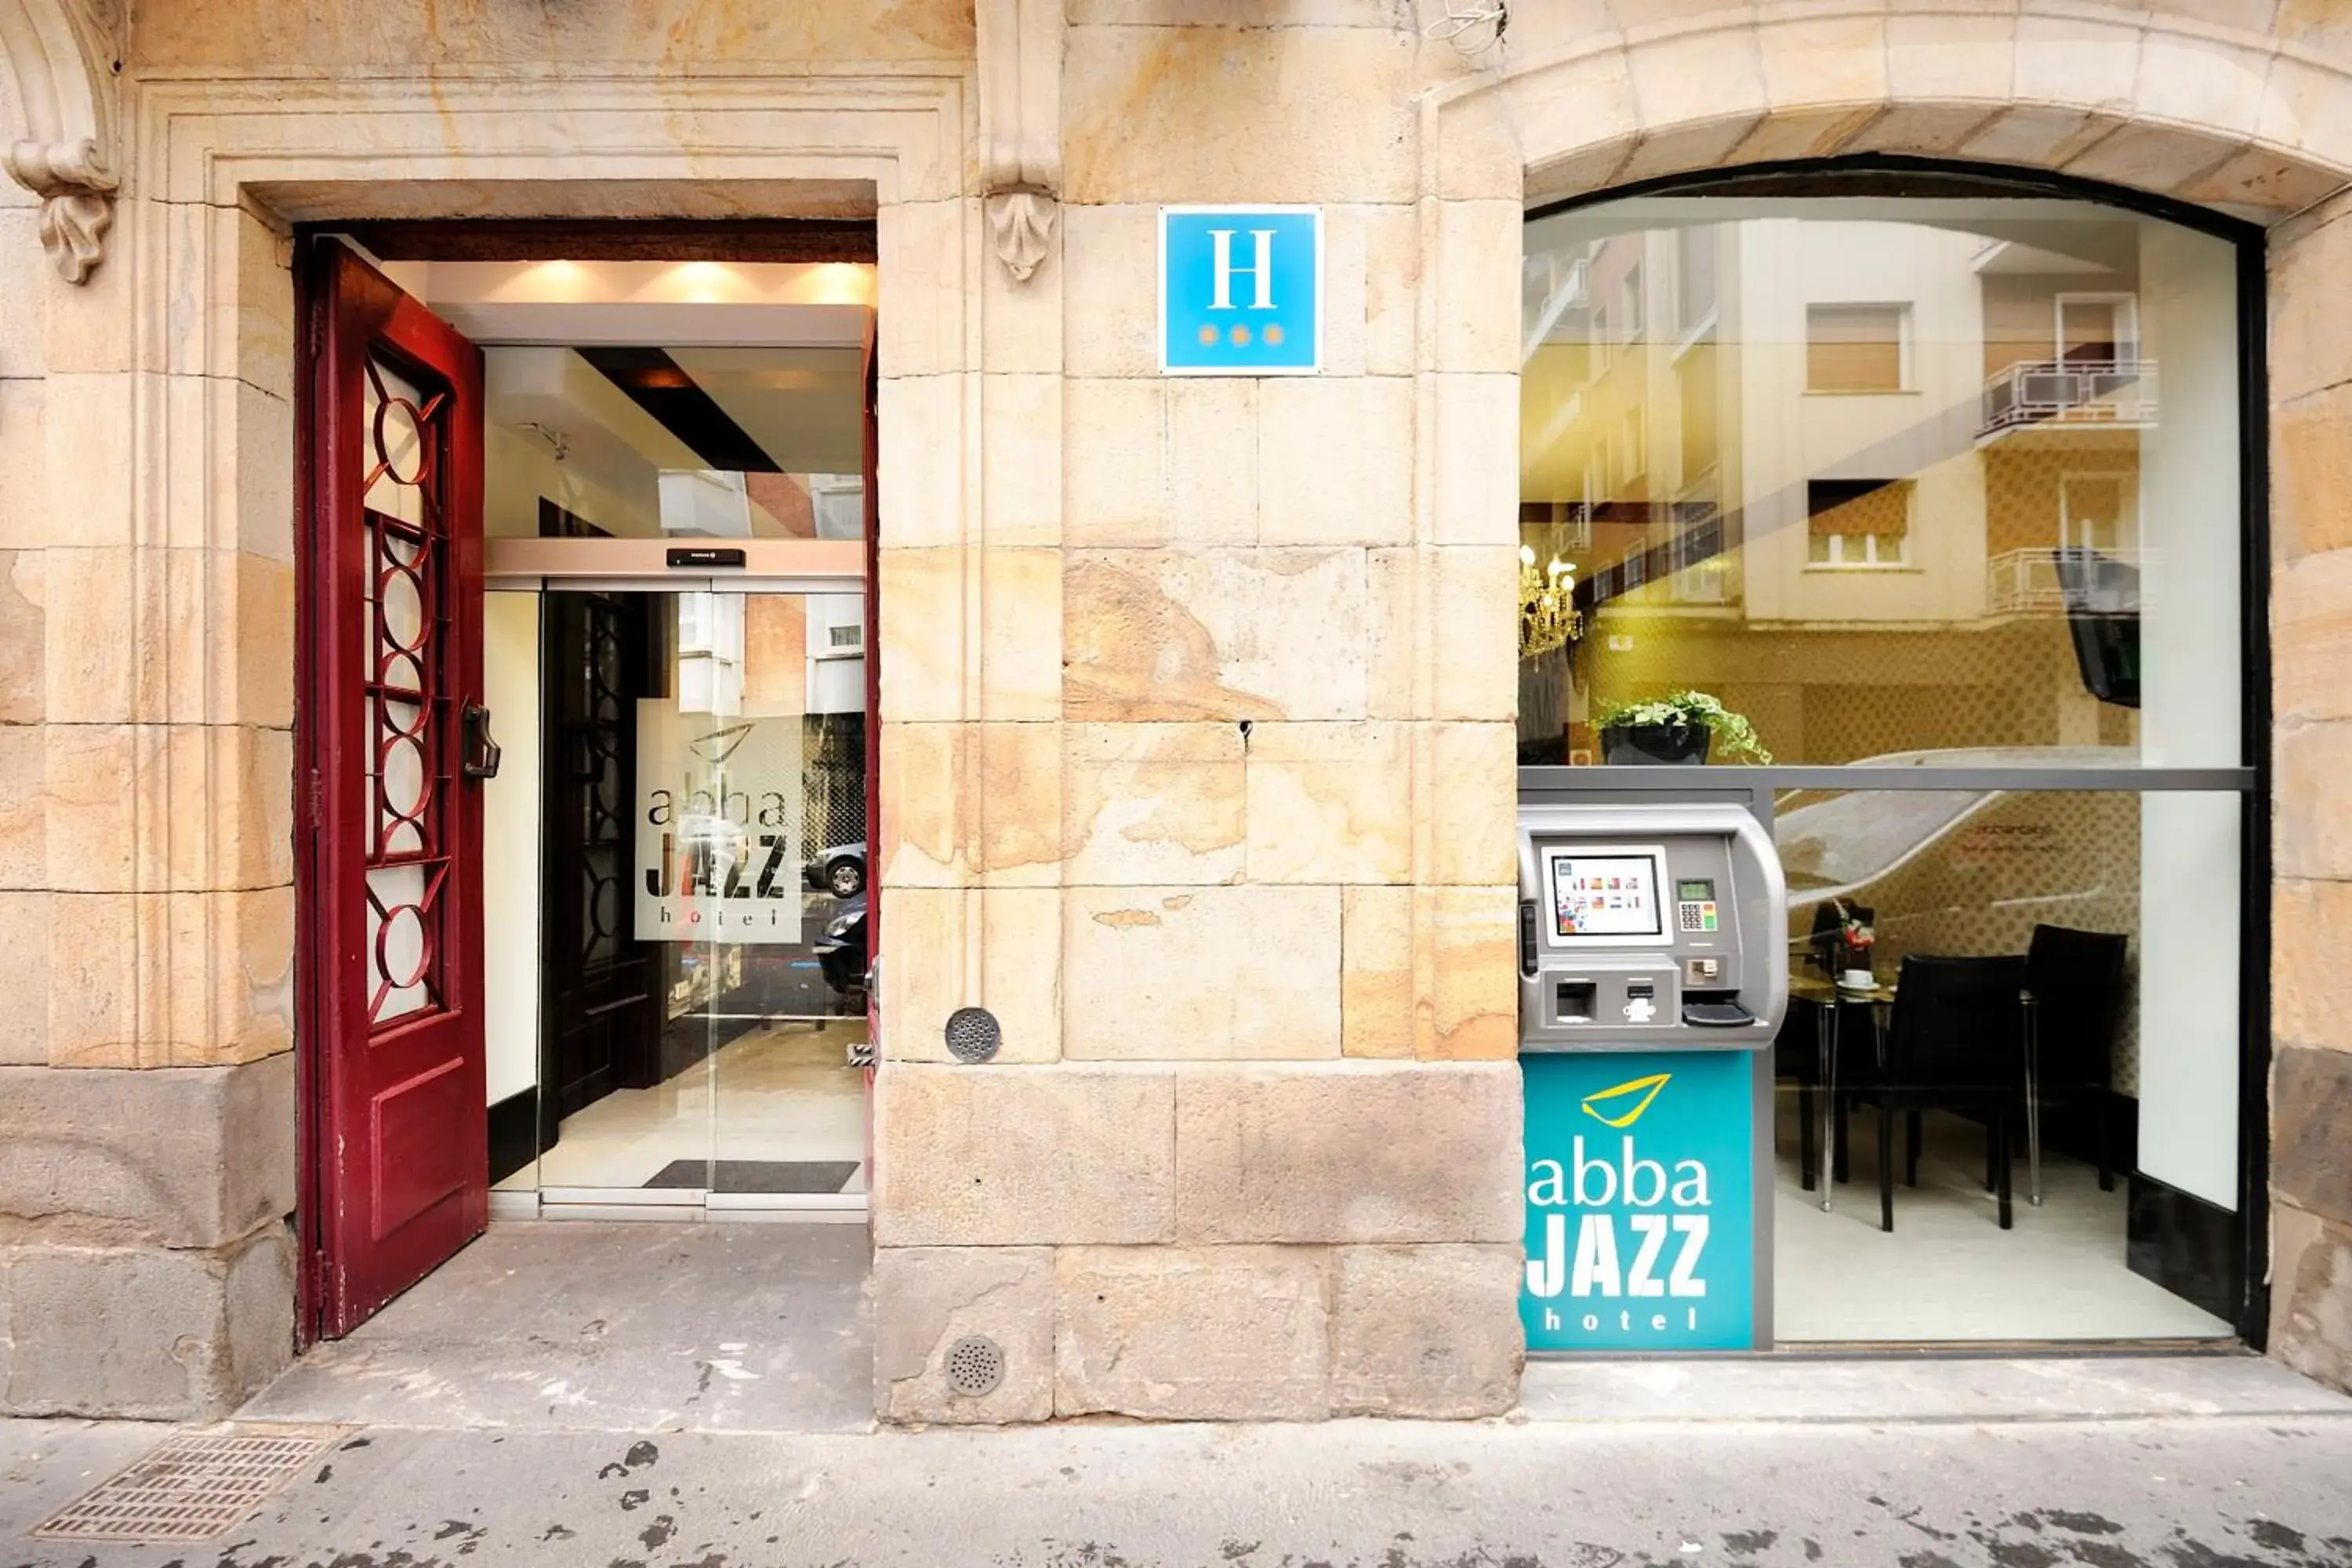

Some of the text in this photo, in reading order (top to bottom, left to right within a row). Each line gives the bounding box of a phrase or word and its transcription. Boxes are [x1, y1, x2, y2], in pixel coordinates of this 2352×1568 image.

[1207, 230, 1278, 310] H
[648, 771, 787, 828] abba
[1527, 1135, 1711, 1207] abba
[1526, 1214, 1709, 1298] JAZZ
[1545, 1308, 1696, 1330] hotel
